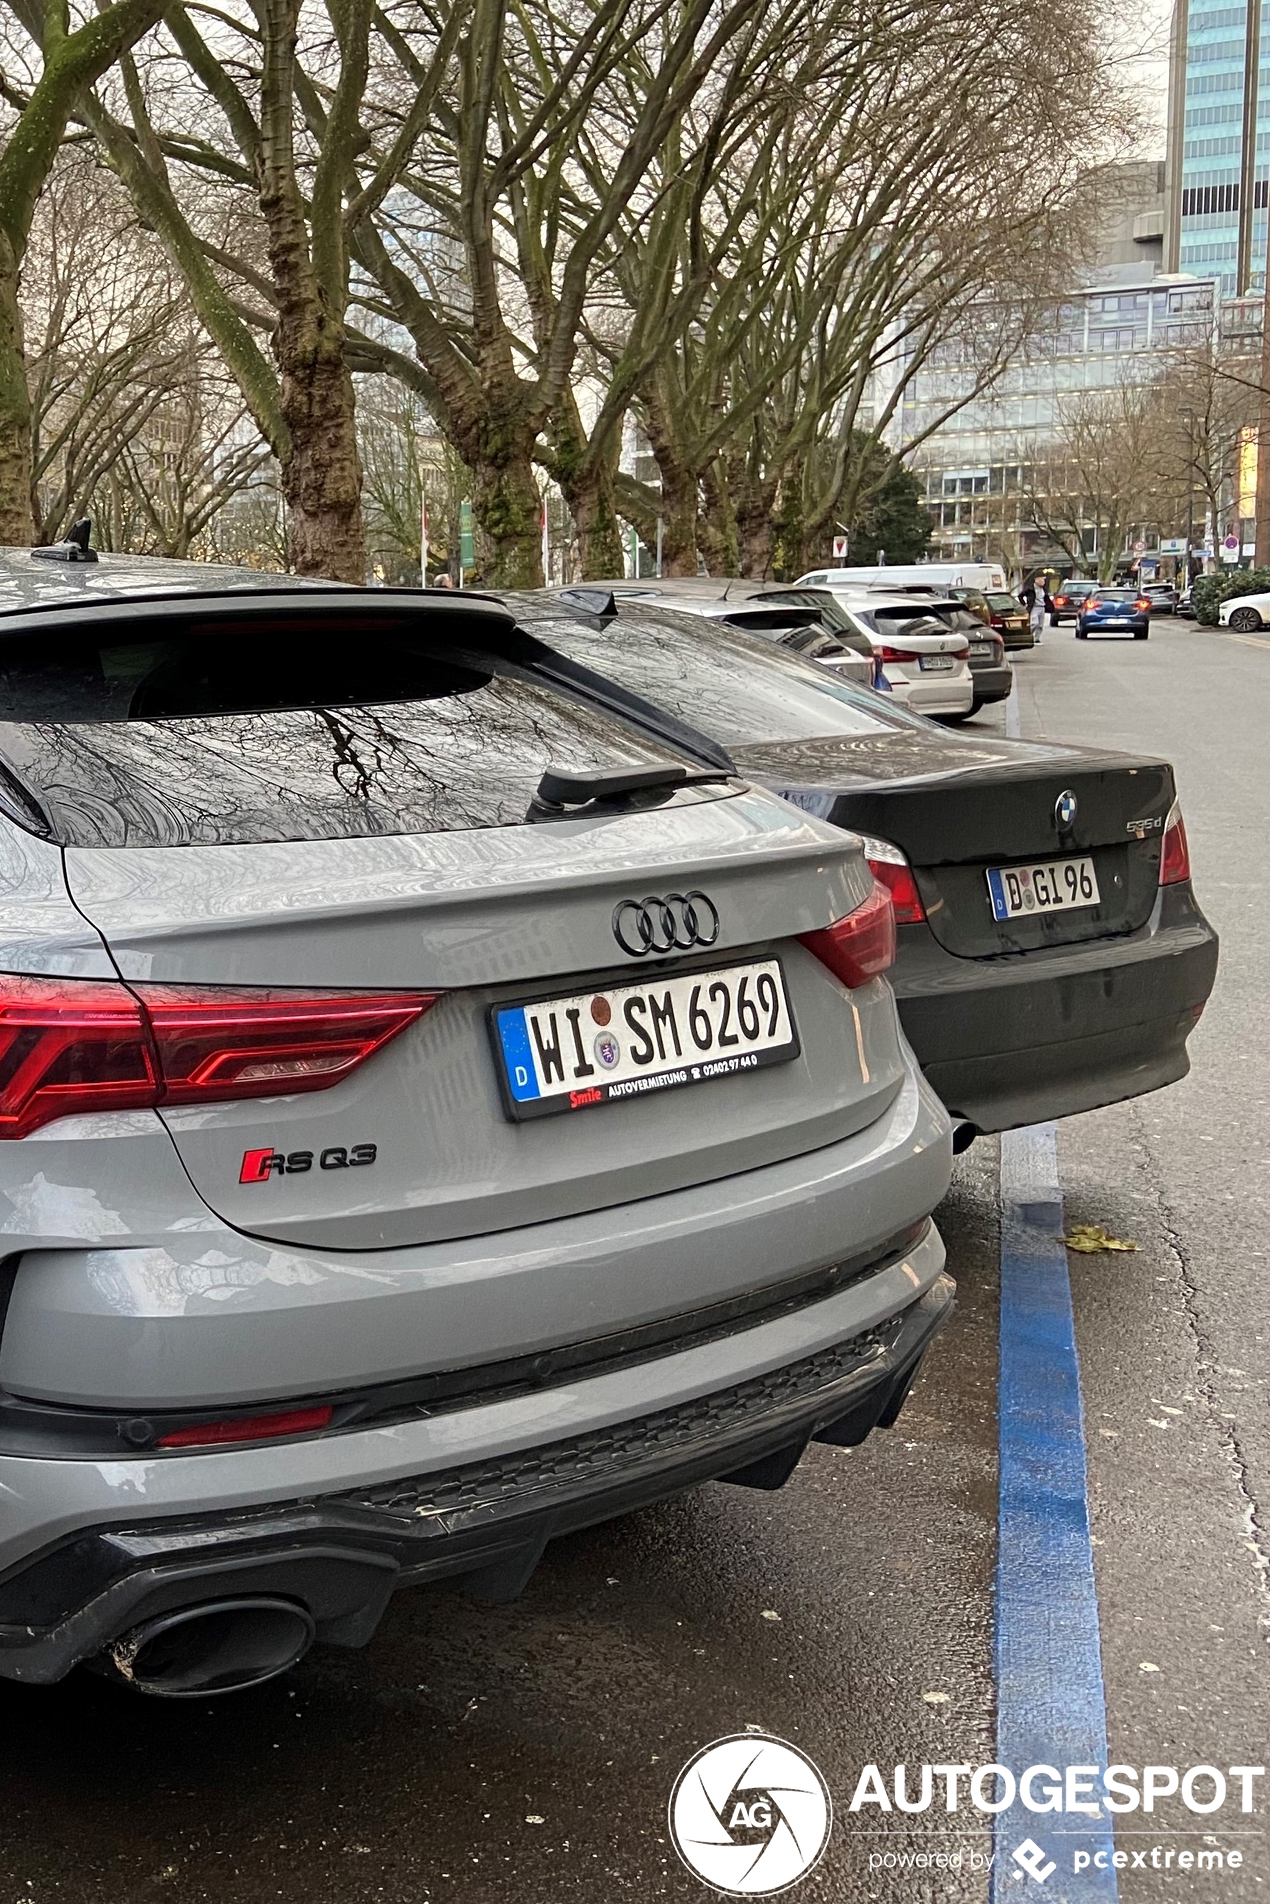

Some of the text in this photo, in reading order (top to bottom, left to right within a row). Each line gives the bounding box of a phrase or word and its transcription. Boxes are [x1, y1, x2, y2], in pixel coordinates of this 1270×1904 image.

[1126, 816, 1162, 833] 535d
[1005, 863, 1093, 911] D GI 96
[530, 972, 780, 1084] WI SM 6269
[515, 1066, 528, 1087] D
[569, 1088, 602, 1109] Smile
[608, 1071, 687, 1098] AUTOVERMIETUNG
[258, 1143, 378, 1177] RS Q3
